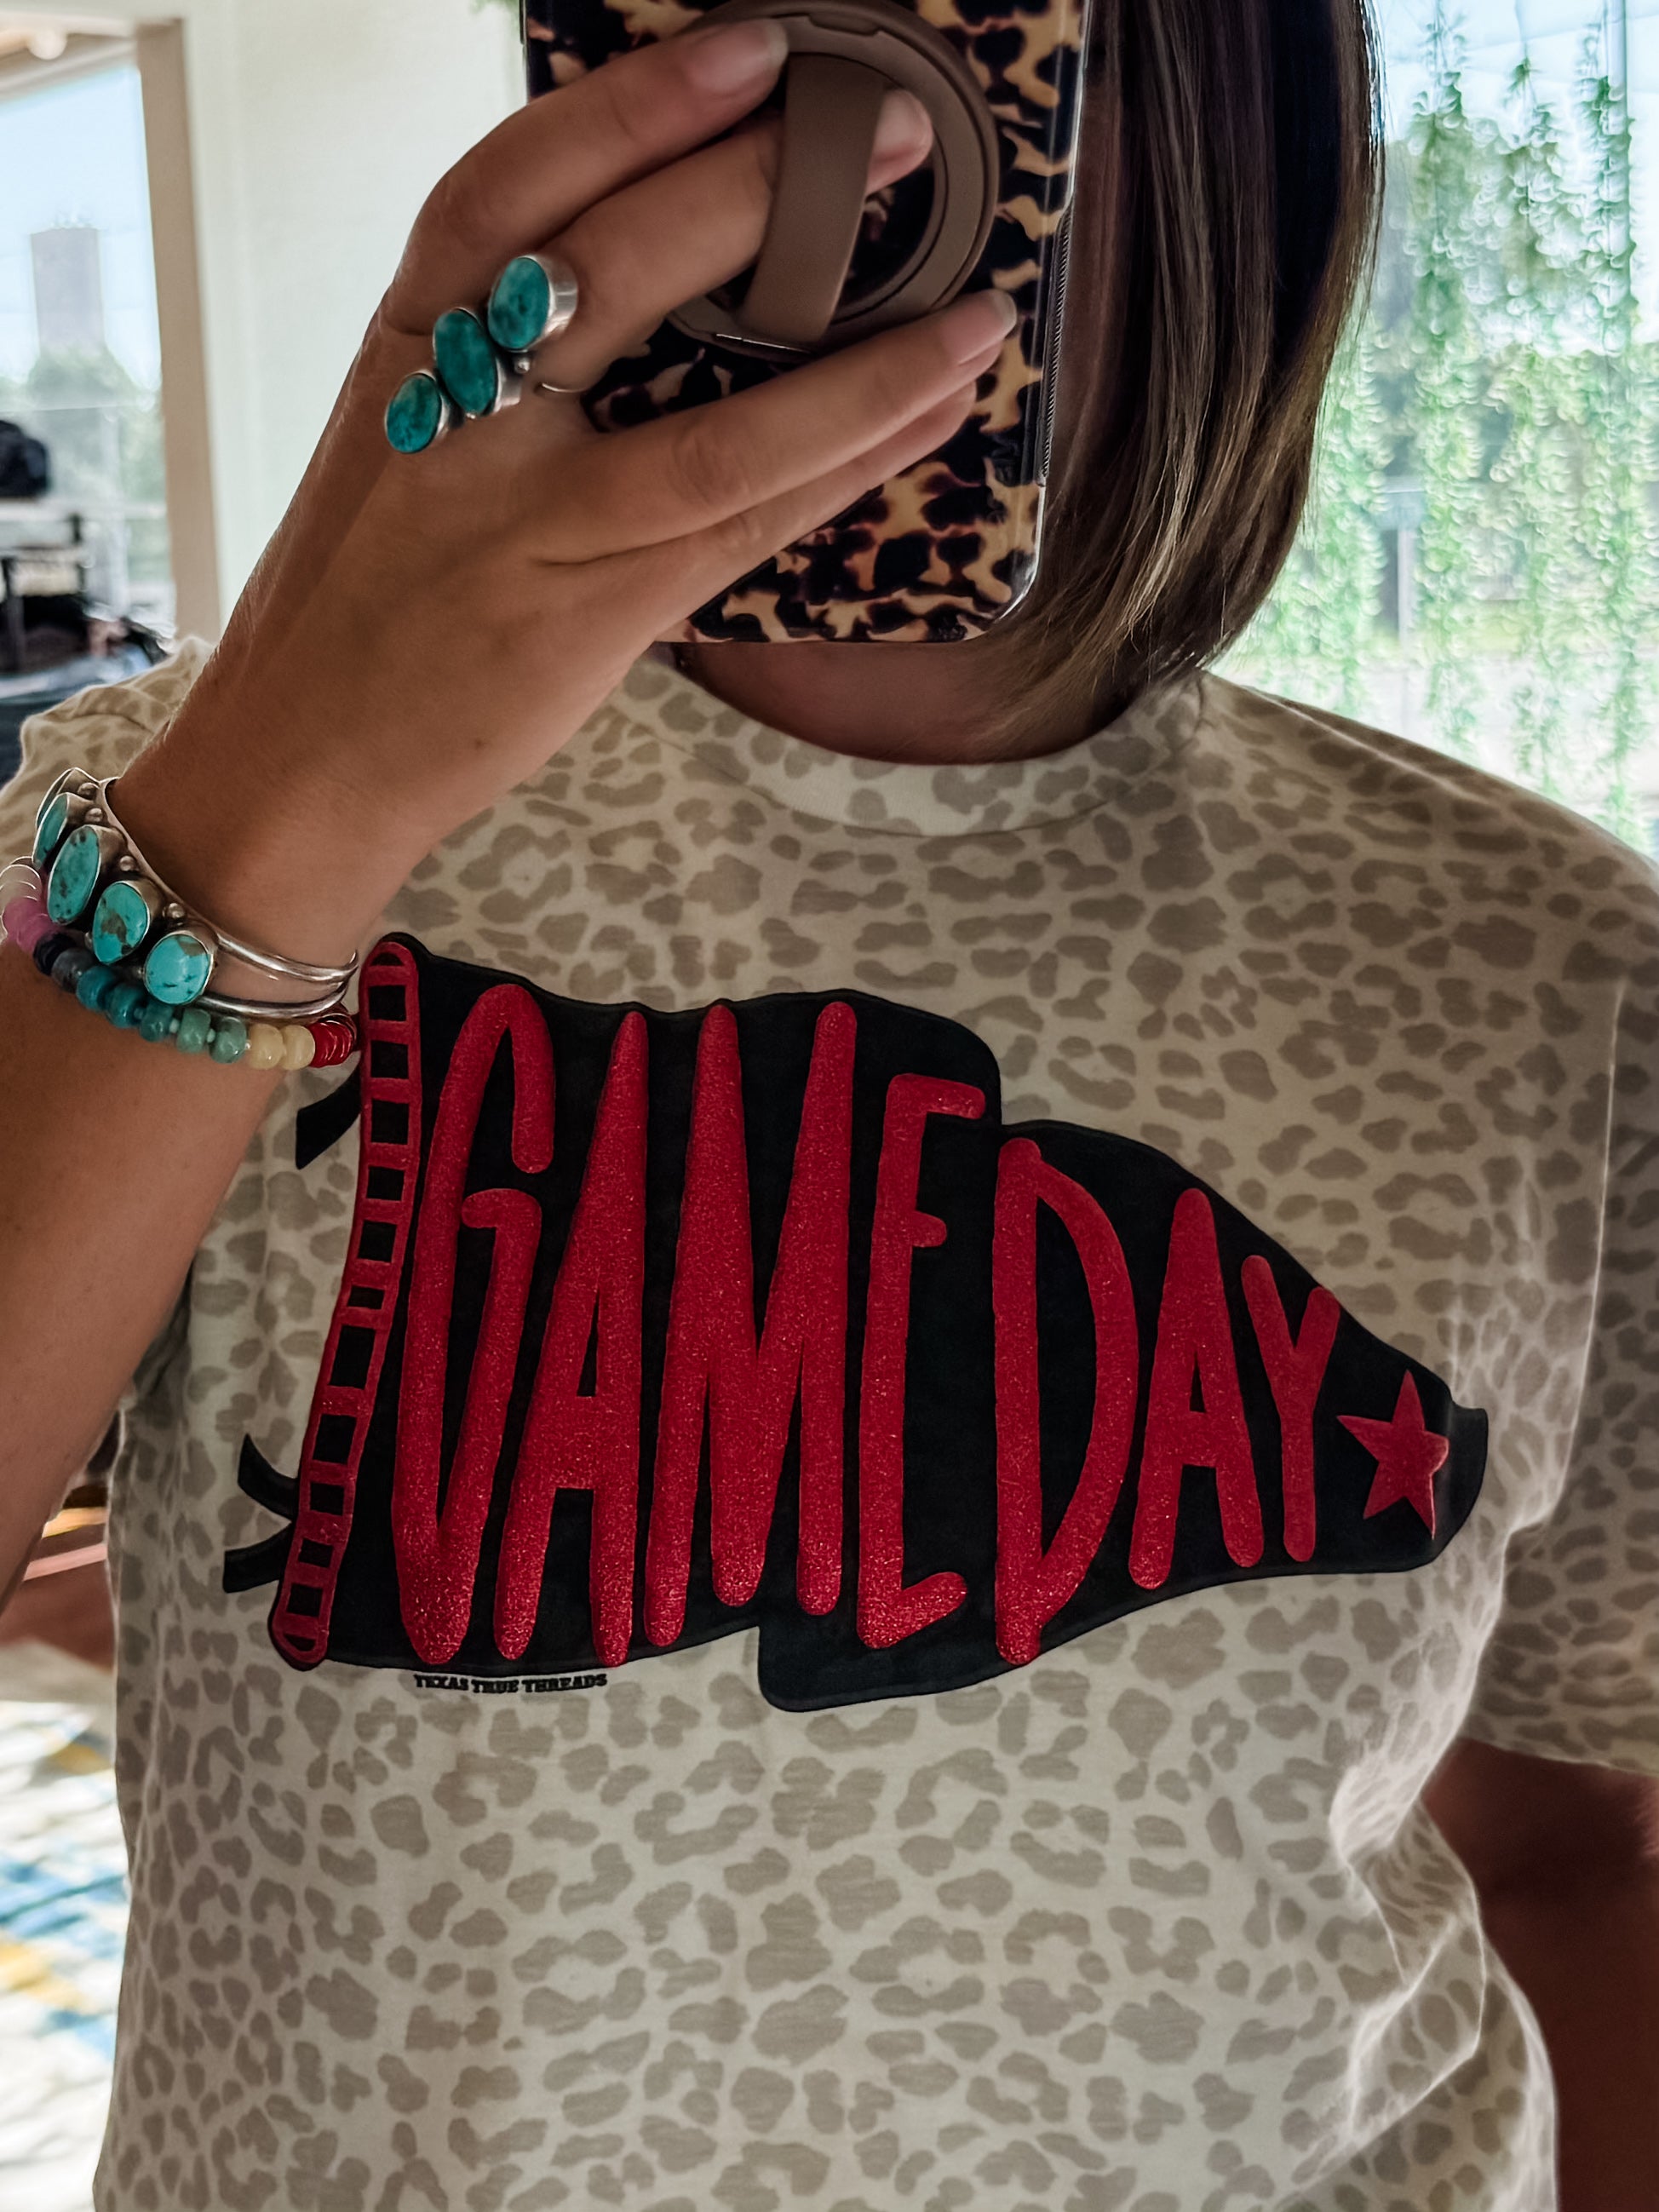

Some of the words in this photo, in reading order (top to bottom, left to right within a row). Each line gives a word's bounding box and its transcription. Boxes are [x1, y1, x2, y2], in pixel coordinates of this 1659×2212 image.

[391, 983, 985, 1666] GAME
[993, 1138, 1339, 1665] DAY
[414, 1674, 468, 1691] TEXAS
[471, 1679, 520, 1693] TRUE
[521, 1674, 607, 1692] THREADS
